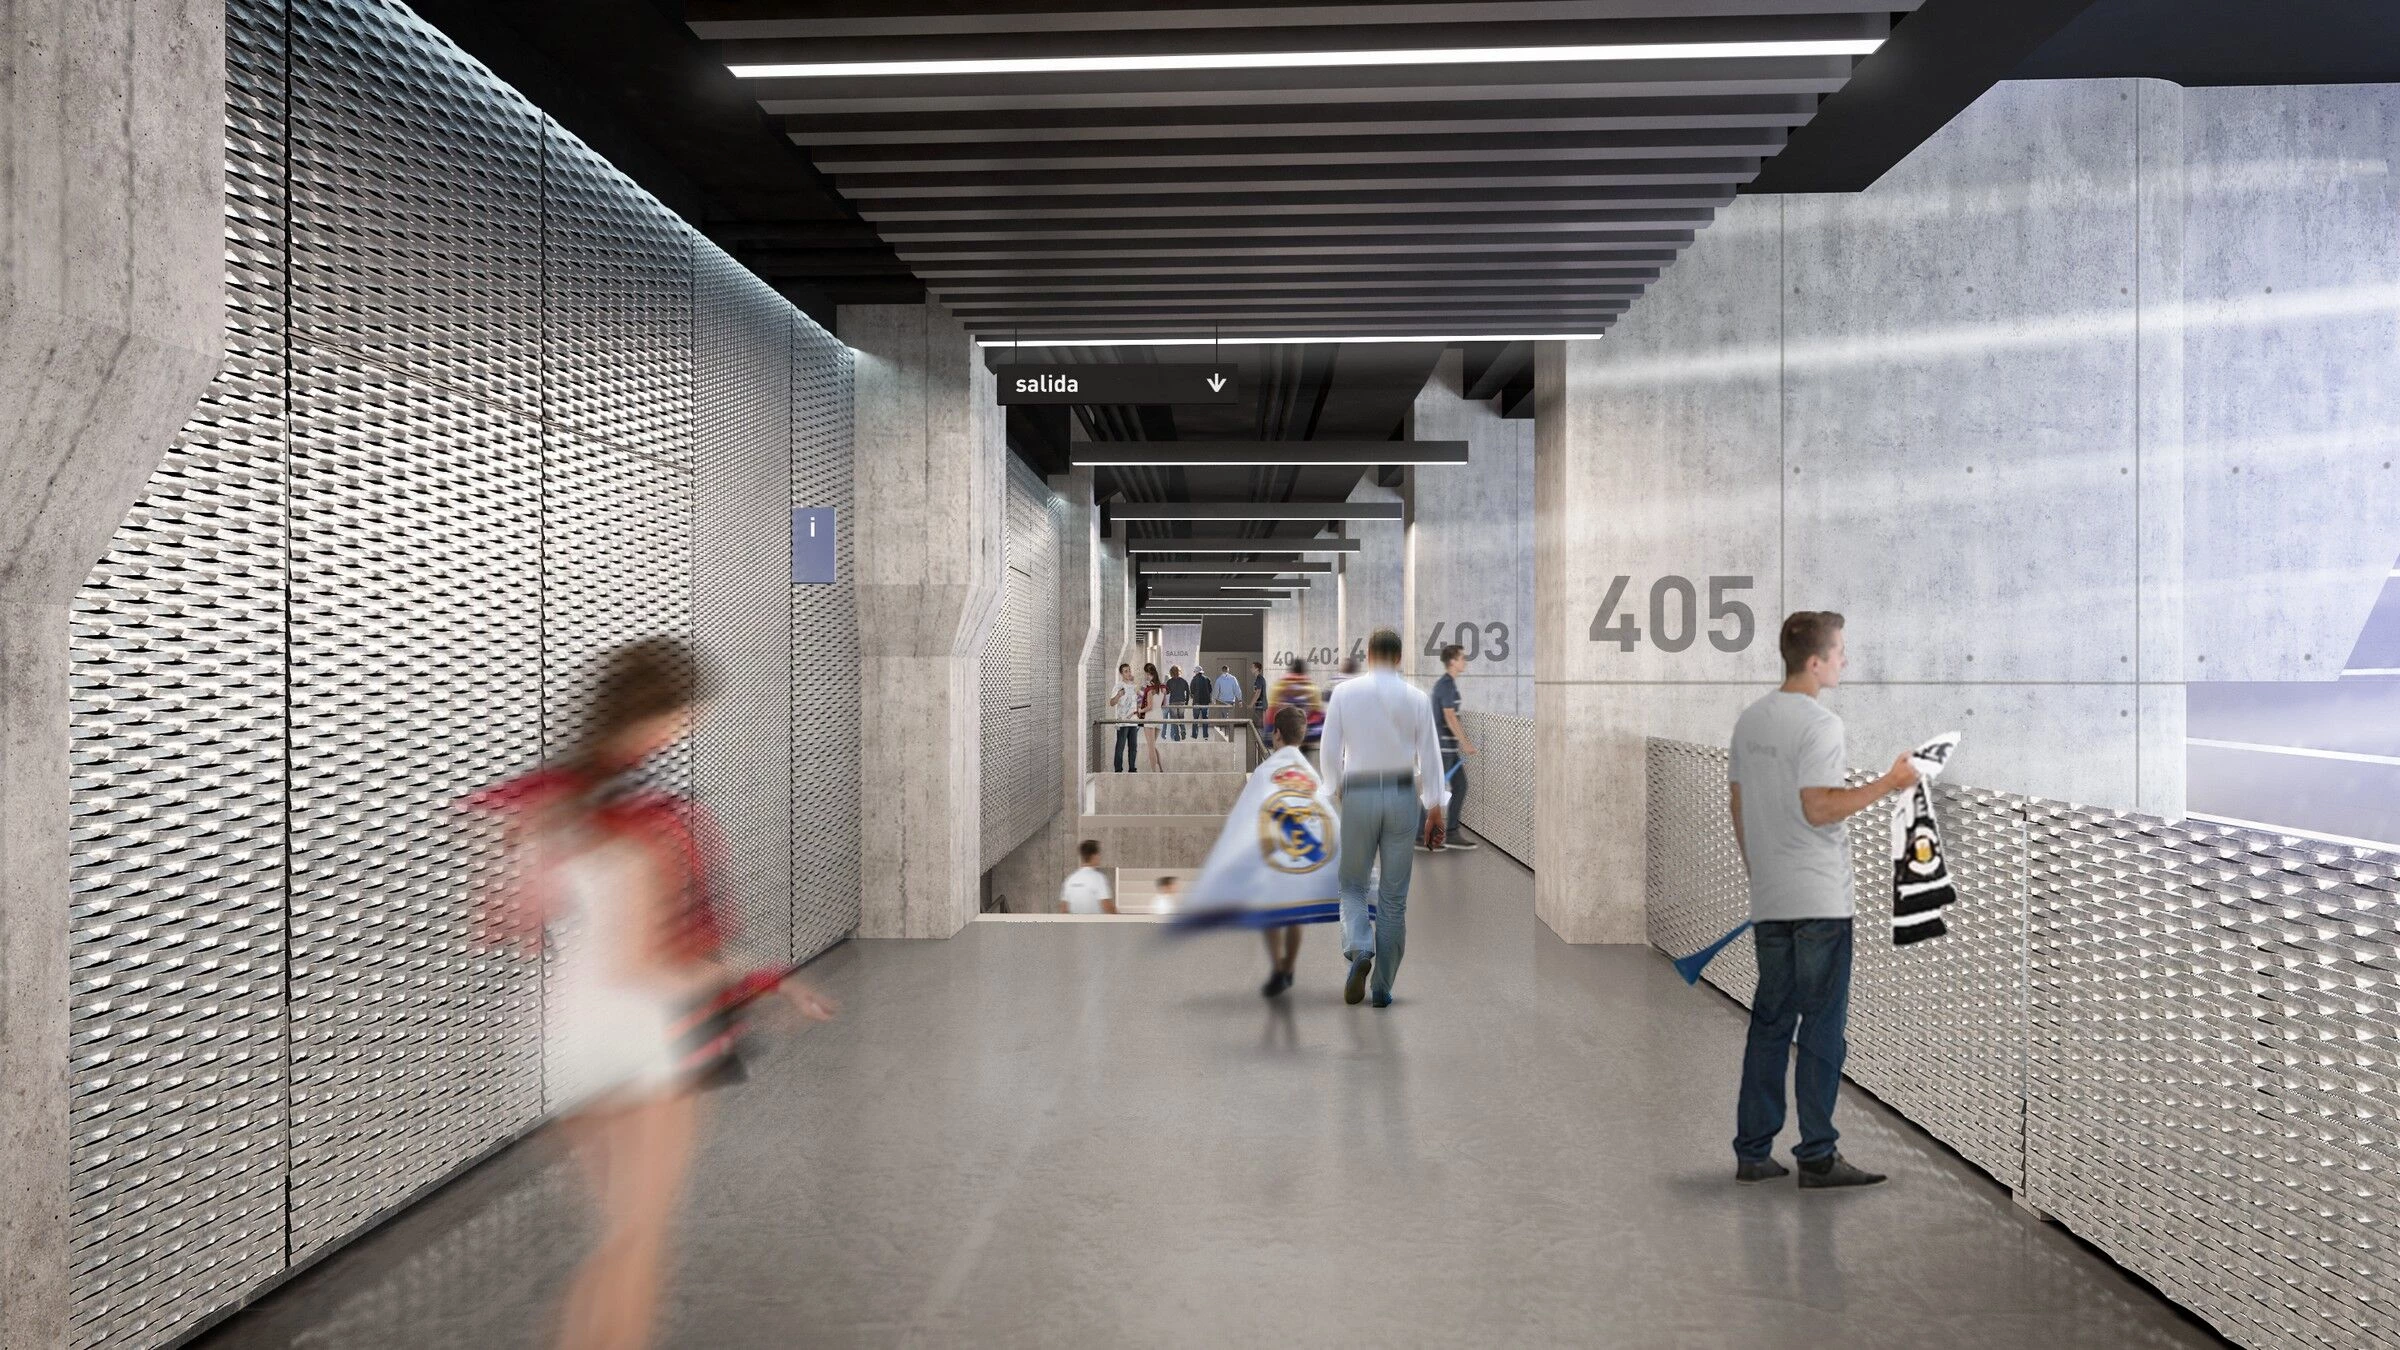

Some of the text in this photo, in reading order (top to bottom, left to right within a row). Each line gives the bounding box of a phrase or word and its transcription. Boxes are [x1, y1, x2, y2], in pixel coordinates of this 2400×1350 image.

[1015, 374, 1079, 393] salida
[809, 516, 816, 538] i
[1589, 575, 1755, 653] 405
[1424, 621, 1510, 662] 403
[1273, 651, 1297, 667] 40
